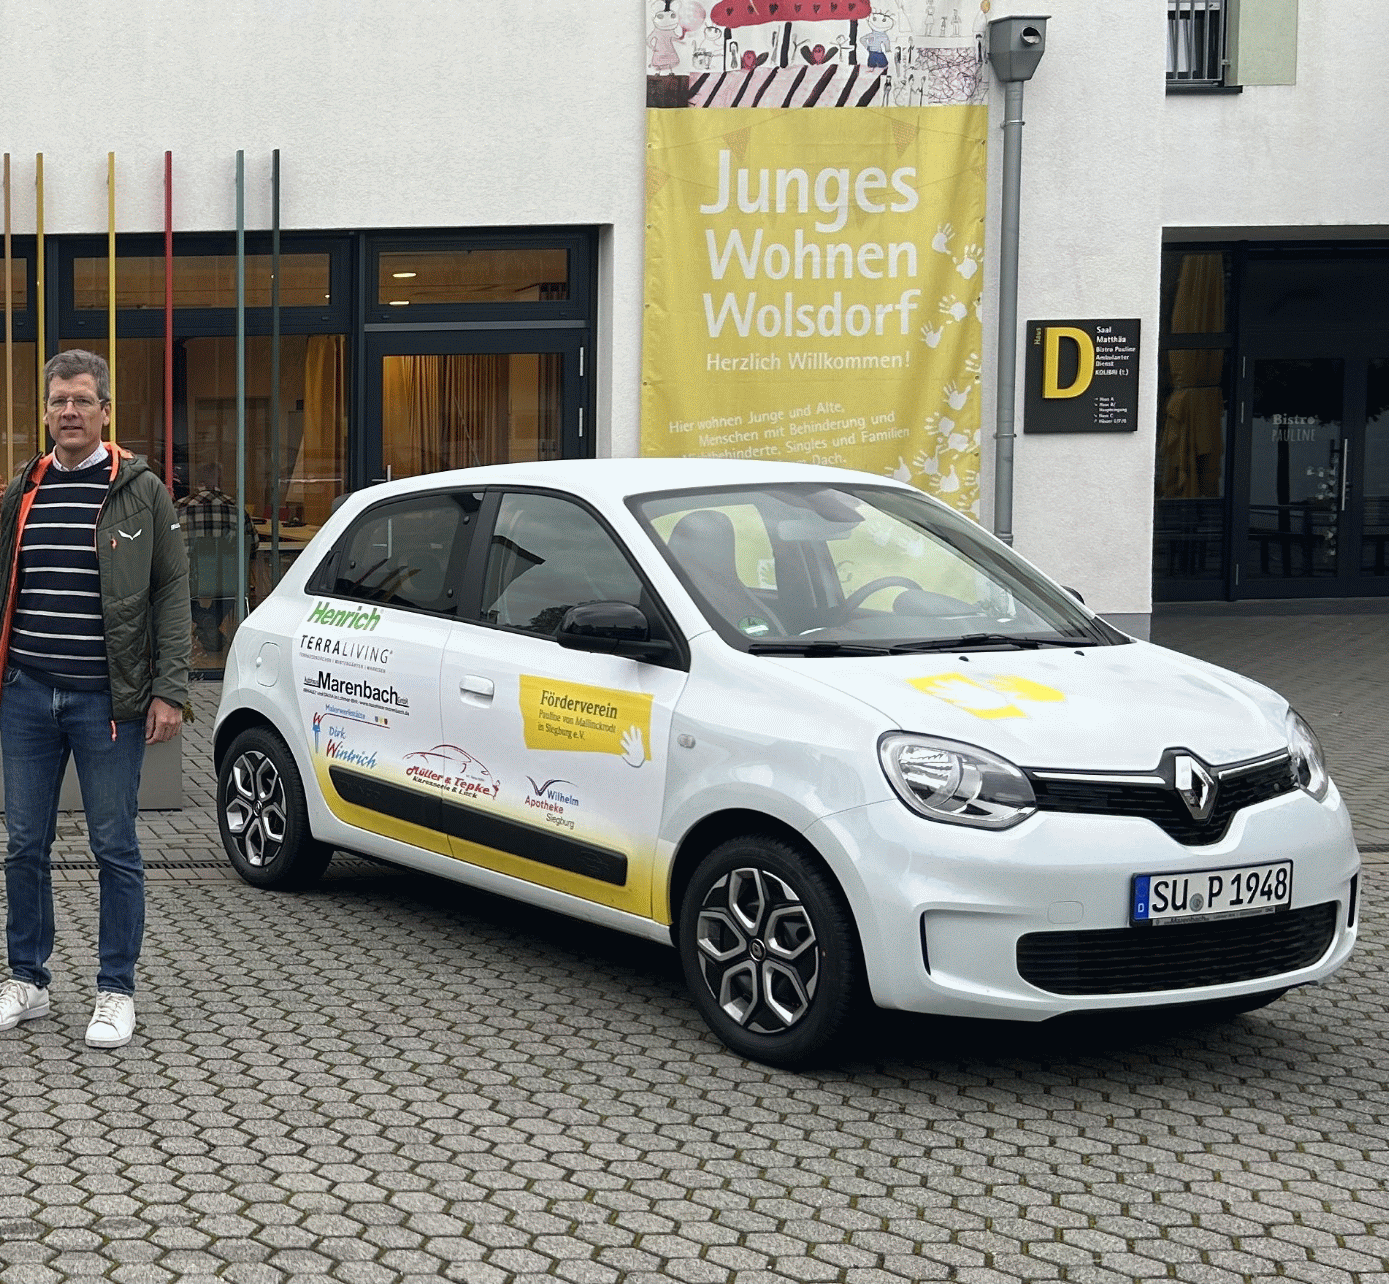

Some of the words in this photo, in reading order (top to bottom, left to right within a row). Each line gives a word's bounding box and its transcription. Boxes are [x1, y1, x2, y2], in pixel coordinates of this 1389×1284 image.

[699, 150, 919, 233] Junges
[705, 228, 917, 280] Wohnen
[703, 288, 921, 338] Wolsdorf
[1033, 328, 1041, 345] Haus
[1096, 326, 1111, 334] Saal
[707, 353, 781, 371] Herzlich
[789, 351, 910, 370] Willkommen!
[1042, 327, 1094, 398] D
[669, 421, 694, 433] Hier
[697, 416, 742, 430] wohnen
[748, 410, 784, 424] Junge
[789, 404, 811, 418] und
[817, 401, 845, 415] Alte,
[699, 430, 758, 447] Menschen
[764, 426, 785, 440] mit
[790, 416, 865, 436] Behinderung
[871, 411, 895, 425] und
[1273, 413, 1315, 424] Bistro
[785, 437, 828, 454] Singles
[833, 433, 856, 448] und
[861, 426, 909, 443] Familien
[812, 453, 847, 466] Dach.
[307, 601, 381, 631] Henrich
[318, 671, 398, 705] Marenbach
[540, 689, 618, 719] Förderverein
[329, 726, 346, 739] Dirk
[538, 709, 561, 722] Pauline
[562, 714, 574, 724] von
[575, 716, 616, 733] Mallinckrodt
[538, 722, 544, 731] in
[545, 724, 572, 740] Siegburg
[326, 738, 377, 769] Wintrich
[406, 766, 443, 781] Müller
[454, 777, 490, 795] Tepke
[525, 795, 564, 814] Apotheke
[547, 789, 579, 806] Wilhelm
[546, 813, 574, 830] Siegburg
[1152, 879, 1189, 913] SU
[1208, 875, 1223, 908] P
[1229, 867, 1288, 906] 1948
[1137, 902, 1145, 913] D
